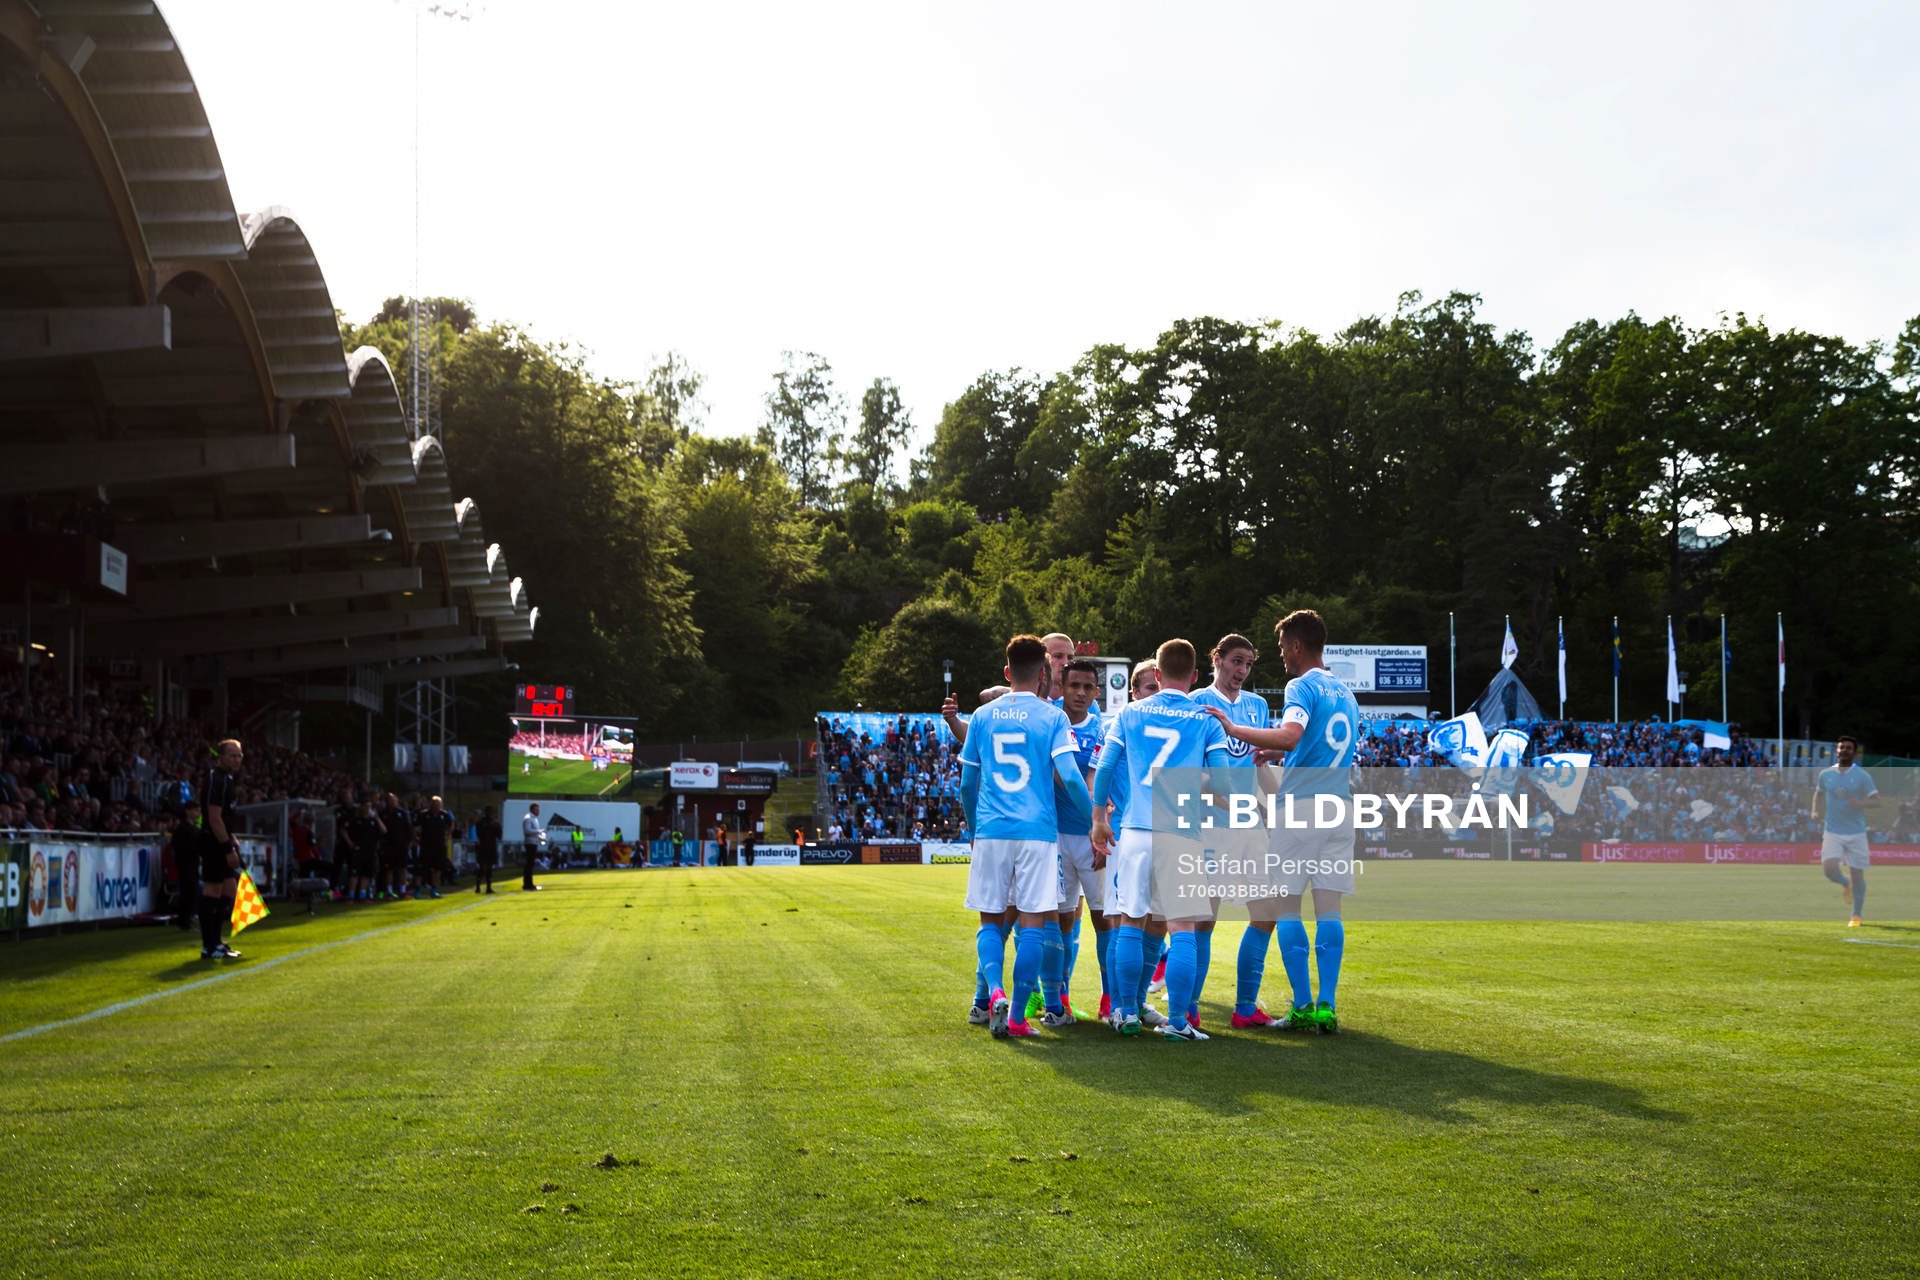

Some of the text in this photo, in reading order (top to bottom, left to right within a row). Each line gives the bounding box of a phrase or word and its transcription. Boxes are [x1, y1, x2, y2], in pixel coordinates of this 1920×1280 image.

[1358, 680, 1370, 688] AB
[992, 707, 1028, 722] Rakip
[992, 733, 1030, 793] 5
[1141, 725, 1181, 787] 7
[1325, 712, 1352, 769] 9
[96, 871, 137, 910] Nordea
